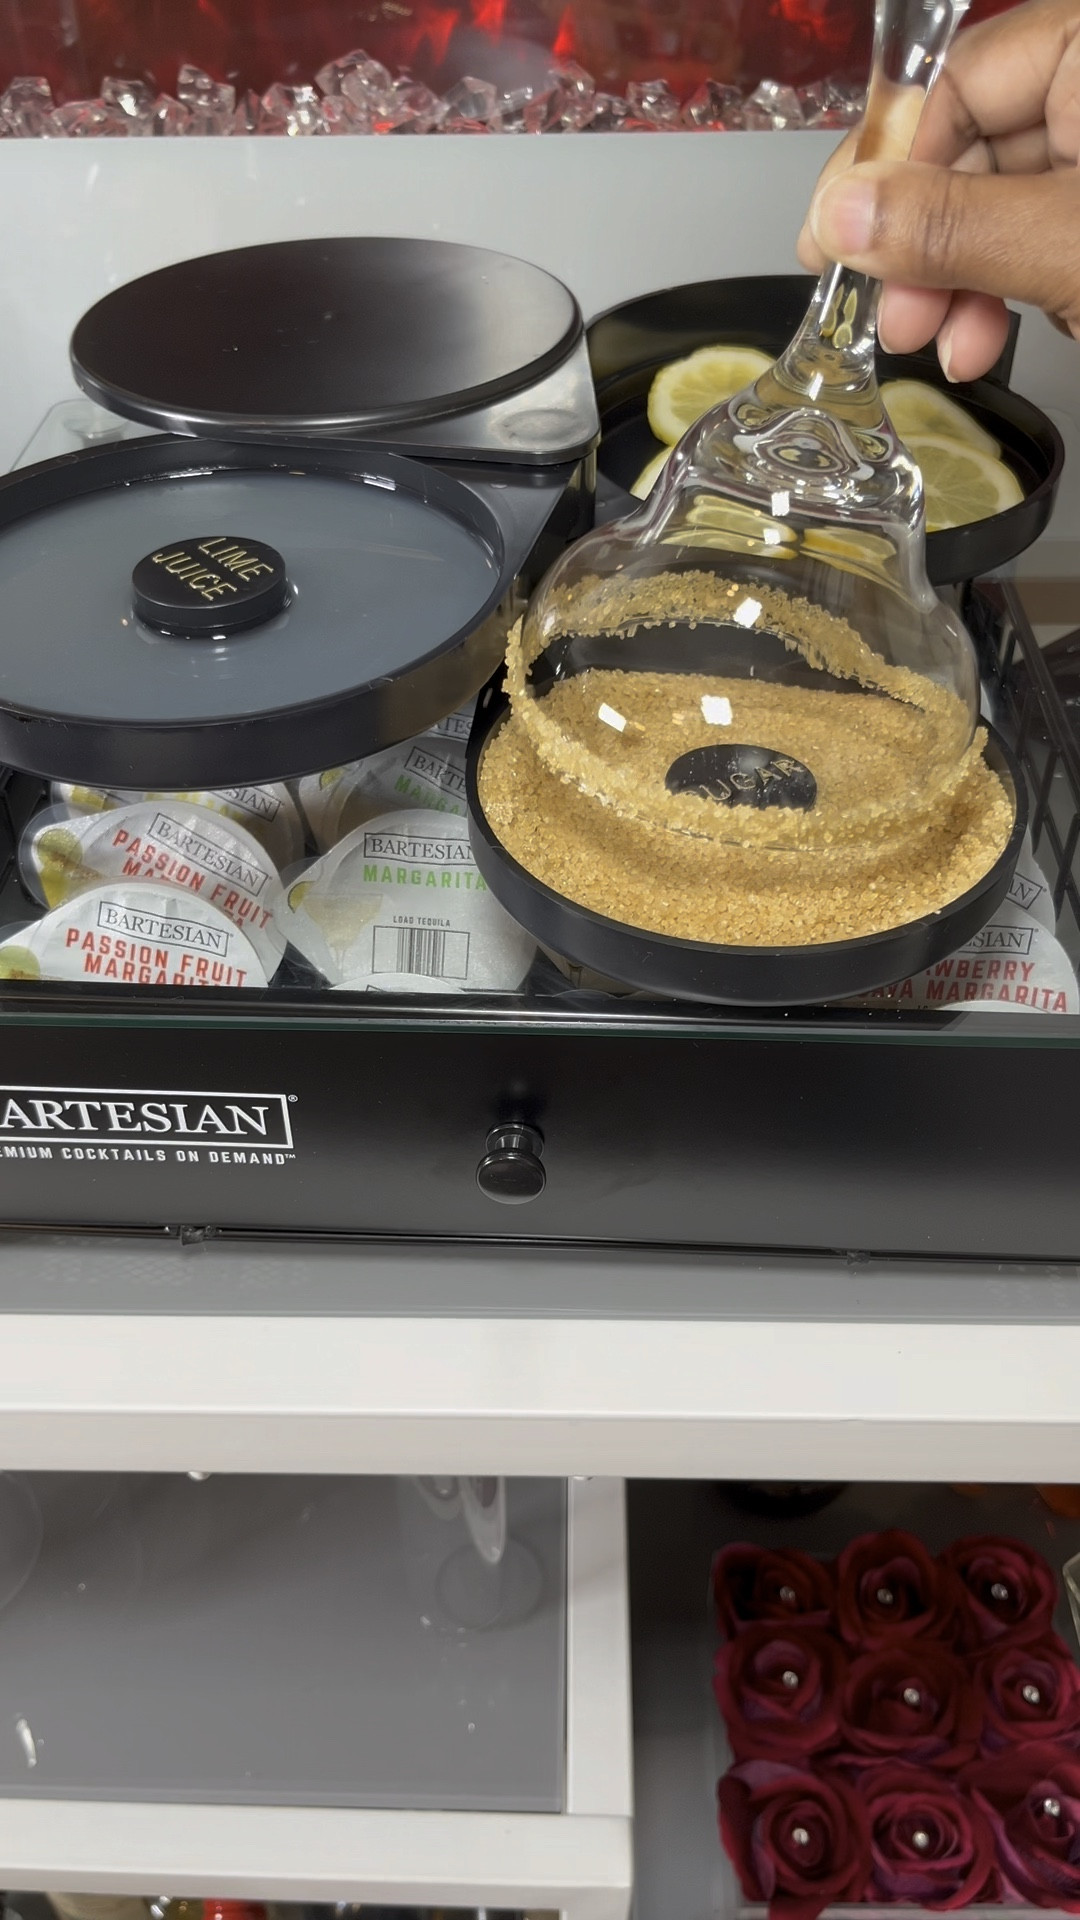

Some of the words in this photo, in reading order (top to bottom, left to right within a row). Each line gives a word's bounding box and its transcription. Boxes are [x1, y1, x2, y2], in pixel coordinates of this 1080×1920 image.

[152, 551, 237, 601] JUICE
[198, 537, 274, 582] LIME
[683, 759, 804, 800] UGAR
[157, 821, 260, 888] BARTESIAN
[112, 829, 206, 892] PASSION
[210, 883, 273, 928] FRUIT
[363, 865, 487, 891] MARGARITA
[106, 909, 223, 949] BARTESIAN
[393, 915, 414, 925] LOAD
[418, 917, 451, 927] TEQUILA
[66, 928, 169, 968] PASSION
[180, 954, 247, 987] FRUIT
[926, 960, 1035, 982] WBERRY
[925, 979, 1067, 1013] MARGARITA
[0, 1099, 269, 1135] ARTESIAN
[62, 1147, 166, 1162] COCKTAILS
[177, 1150, 199, 1162] ON
